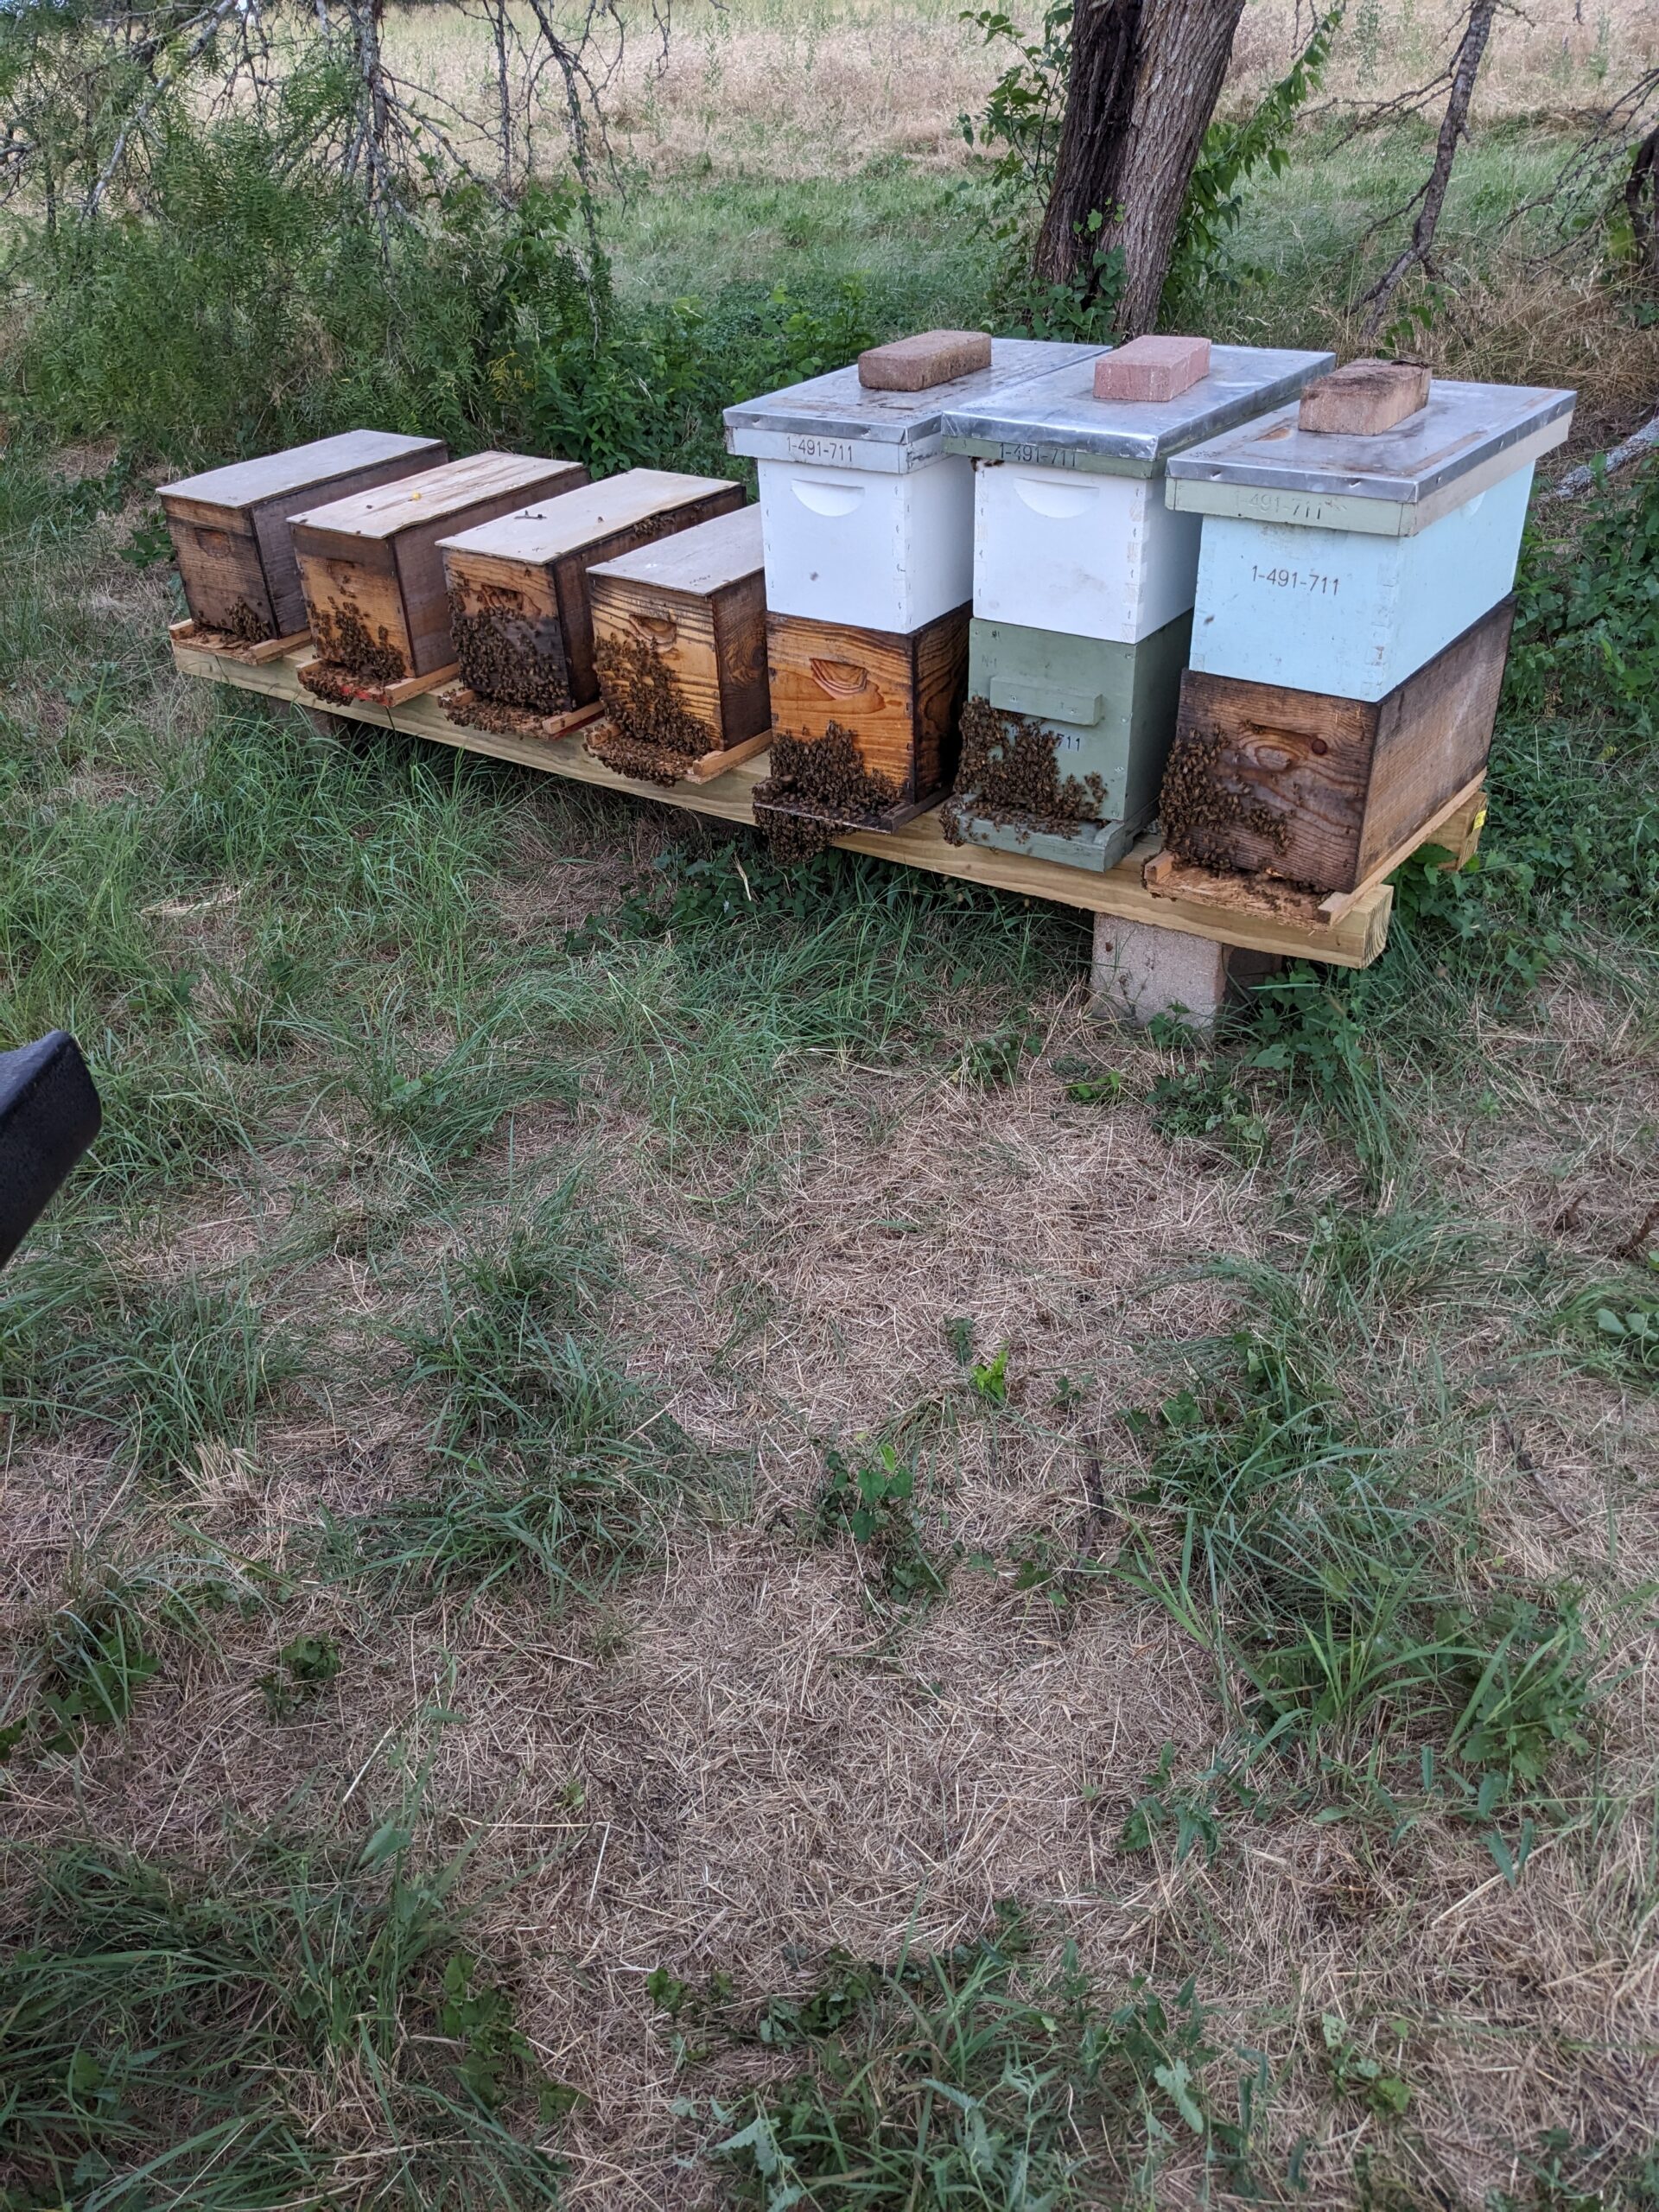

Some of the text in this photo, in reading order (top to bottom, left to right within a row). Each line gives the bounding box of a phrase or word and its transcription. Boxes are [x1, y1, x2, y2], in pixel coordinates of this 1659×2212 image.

[787, 436, 852, 462] 1-491-711
[1000, 442, 1077, 467] 1-491-711
[1252, 565, 1338, 596] 1-491-711
